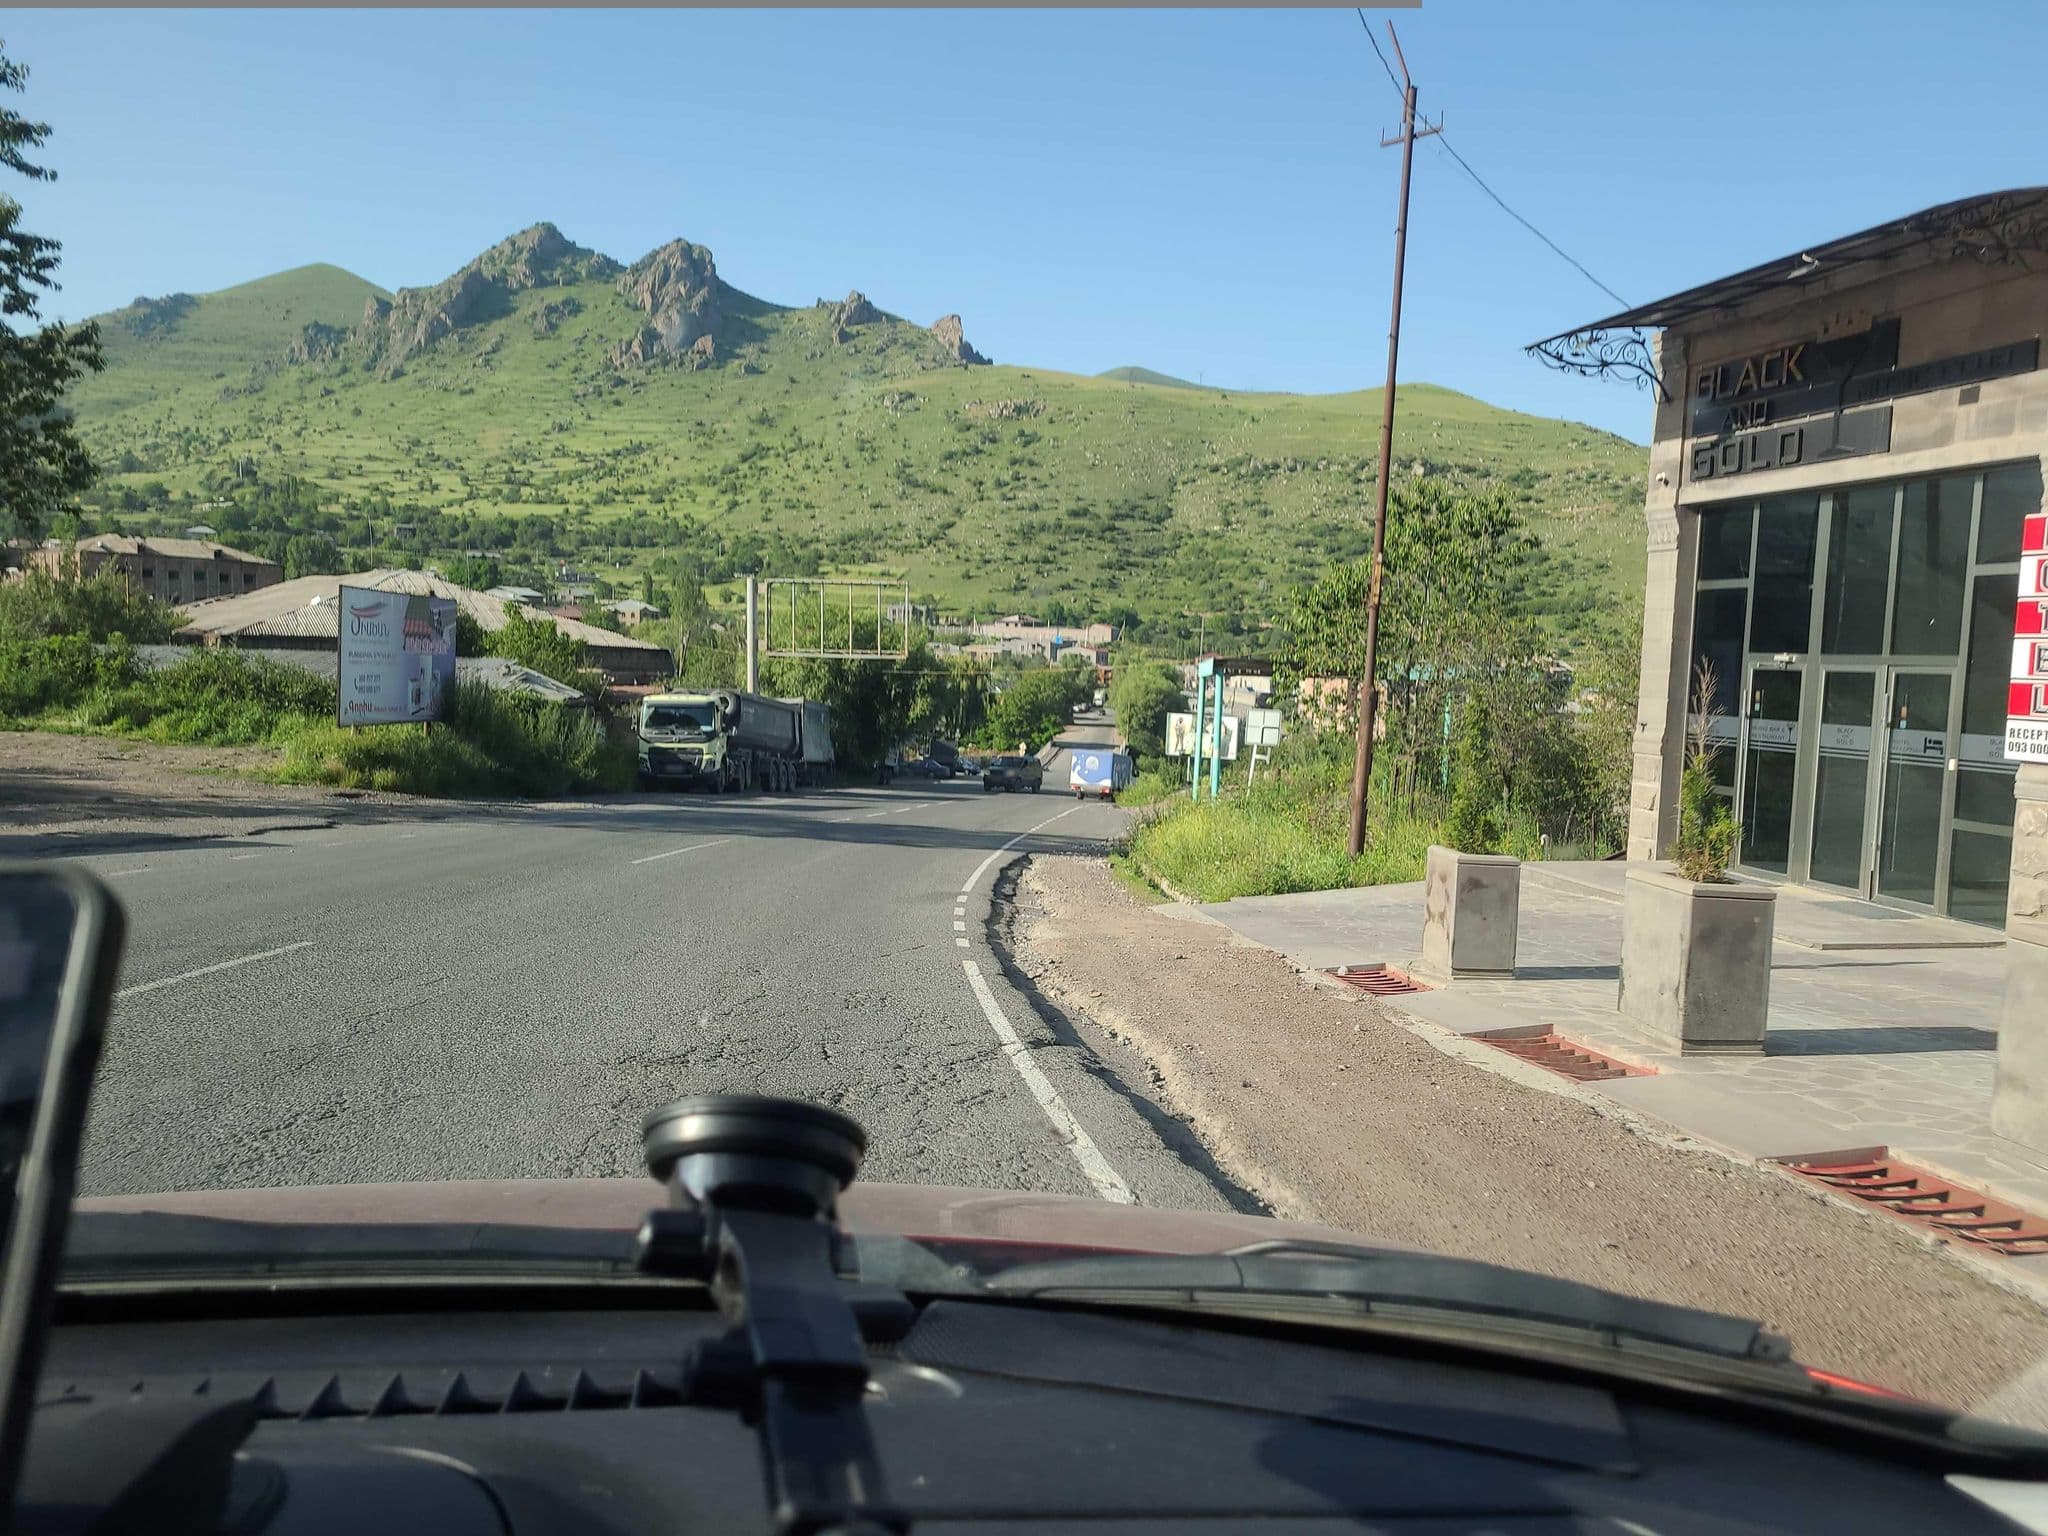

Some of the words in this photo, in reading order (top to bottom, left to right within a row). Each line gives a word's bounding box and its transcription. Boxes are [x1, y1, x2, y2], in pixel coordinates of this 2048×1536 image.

[1696, 344, 1806, 401] BLACK
[1720, 399, 1768, 434] AND
[1691, 427, 1805, 481] GOLD
[2008, 741, 2028, 754] 093
